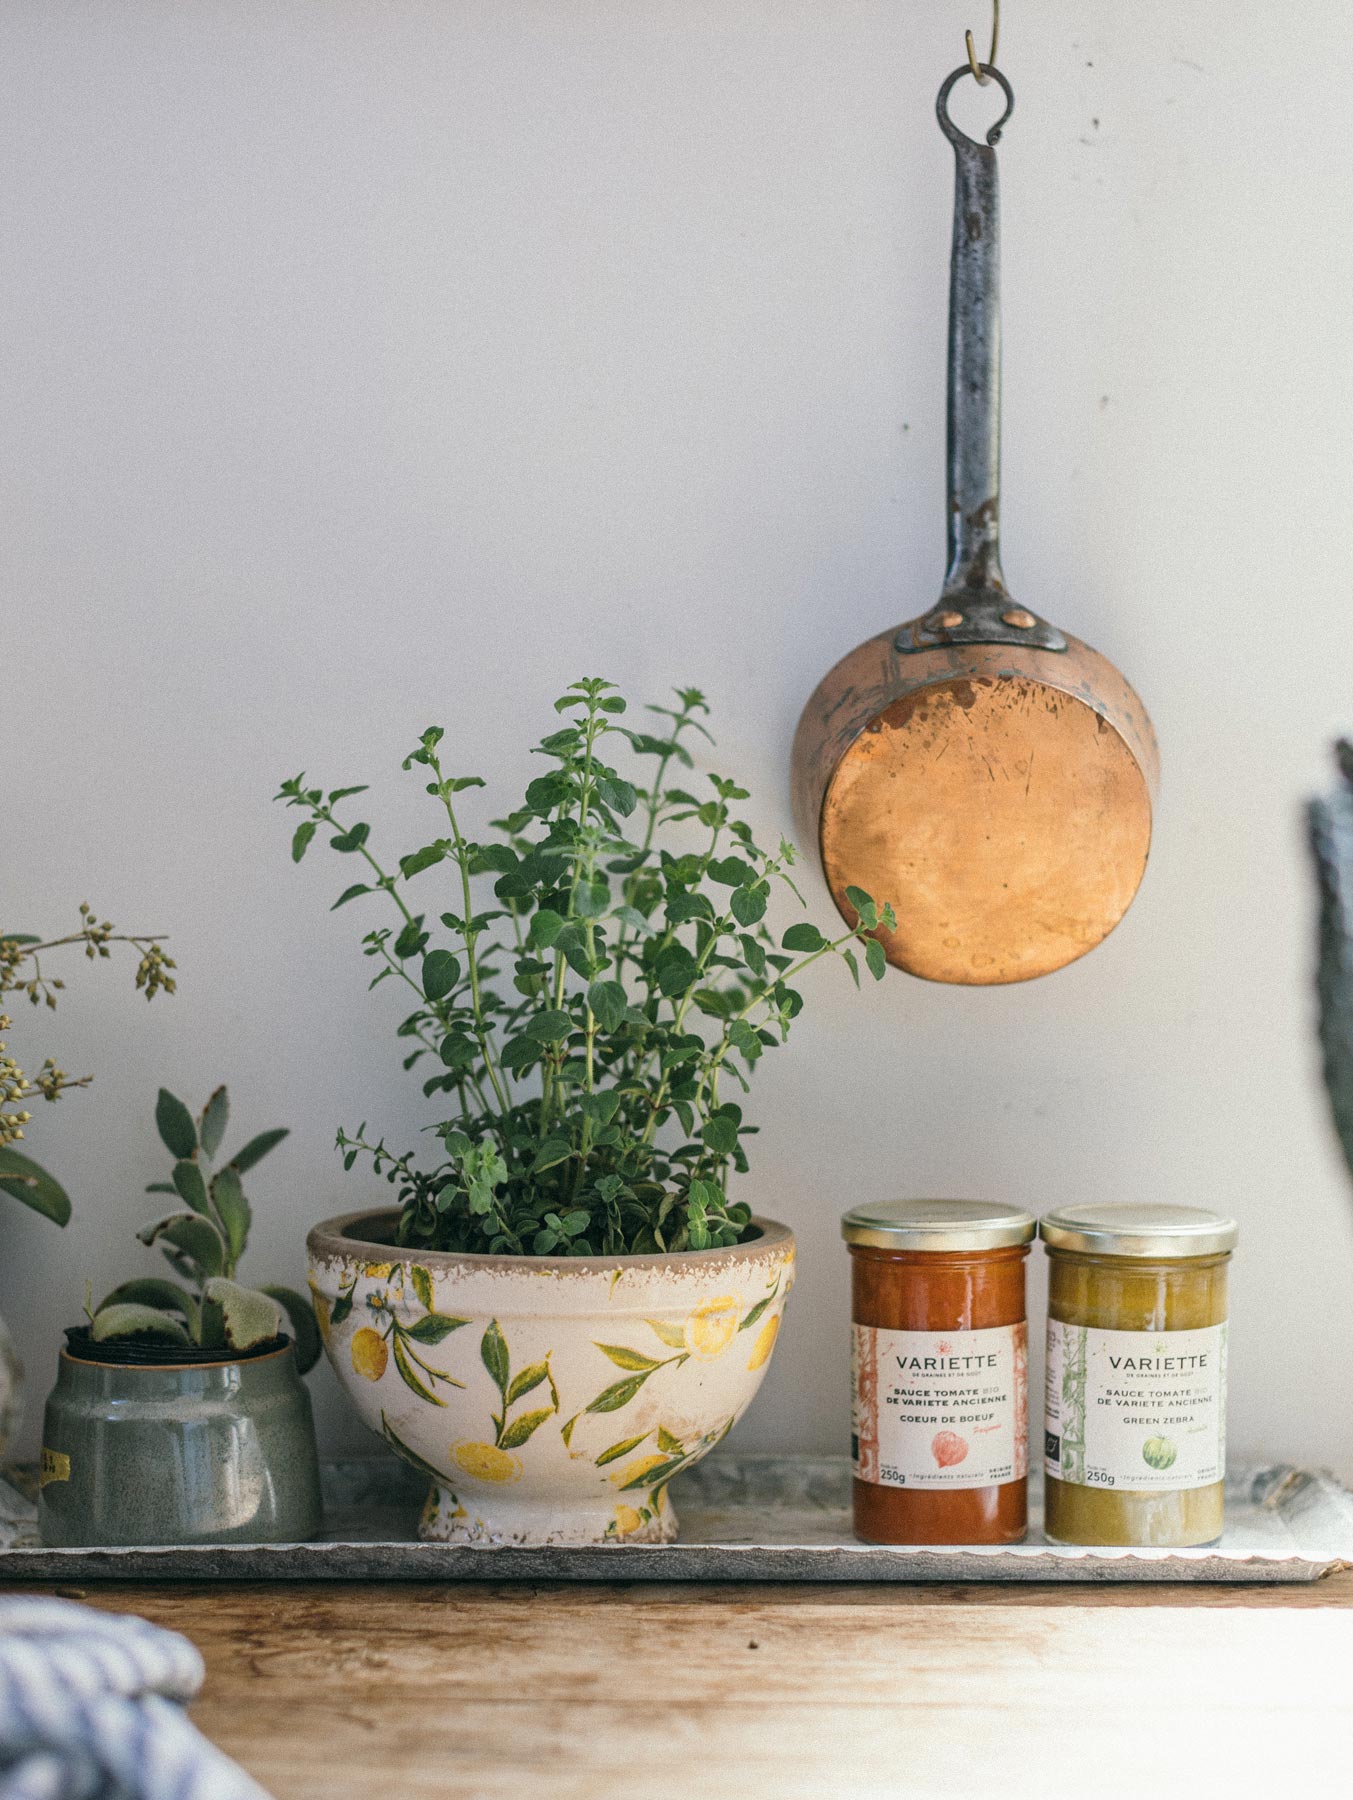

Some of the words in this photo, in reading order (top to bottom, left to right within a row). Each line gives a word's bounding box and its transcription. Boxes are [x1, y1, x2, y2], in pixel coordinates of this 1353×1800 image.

[896, 1354, 997, 1370] VARIETTE
[1109, 1354, 1207, 1370] VARIETTE
[894, 1388, 930, 1396] SAUCE
[1106, 1389, 1144, 1397] SAUCE
[1148, 1389, 1191, 1397] TOMATE
[902, 1398, 948, 1406] VARIETE
[953, 1395, 1007, 1406] ANCIENNE
[1116, 1398, 1164, 1407] VARIETE
[1168, 1396, 1212, 1406] ANCIENNE
[900, 1415, 937, 1423] COEUR
[942, 1415, 956, 1423] DE
[960, 1413, 995, 1423] BOEUF
[881, 1469, 905, 1484] 250g
[1087, 1471, 1114, 1485] 250g
